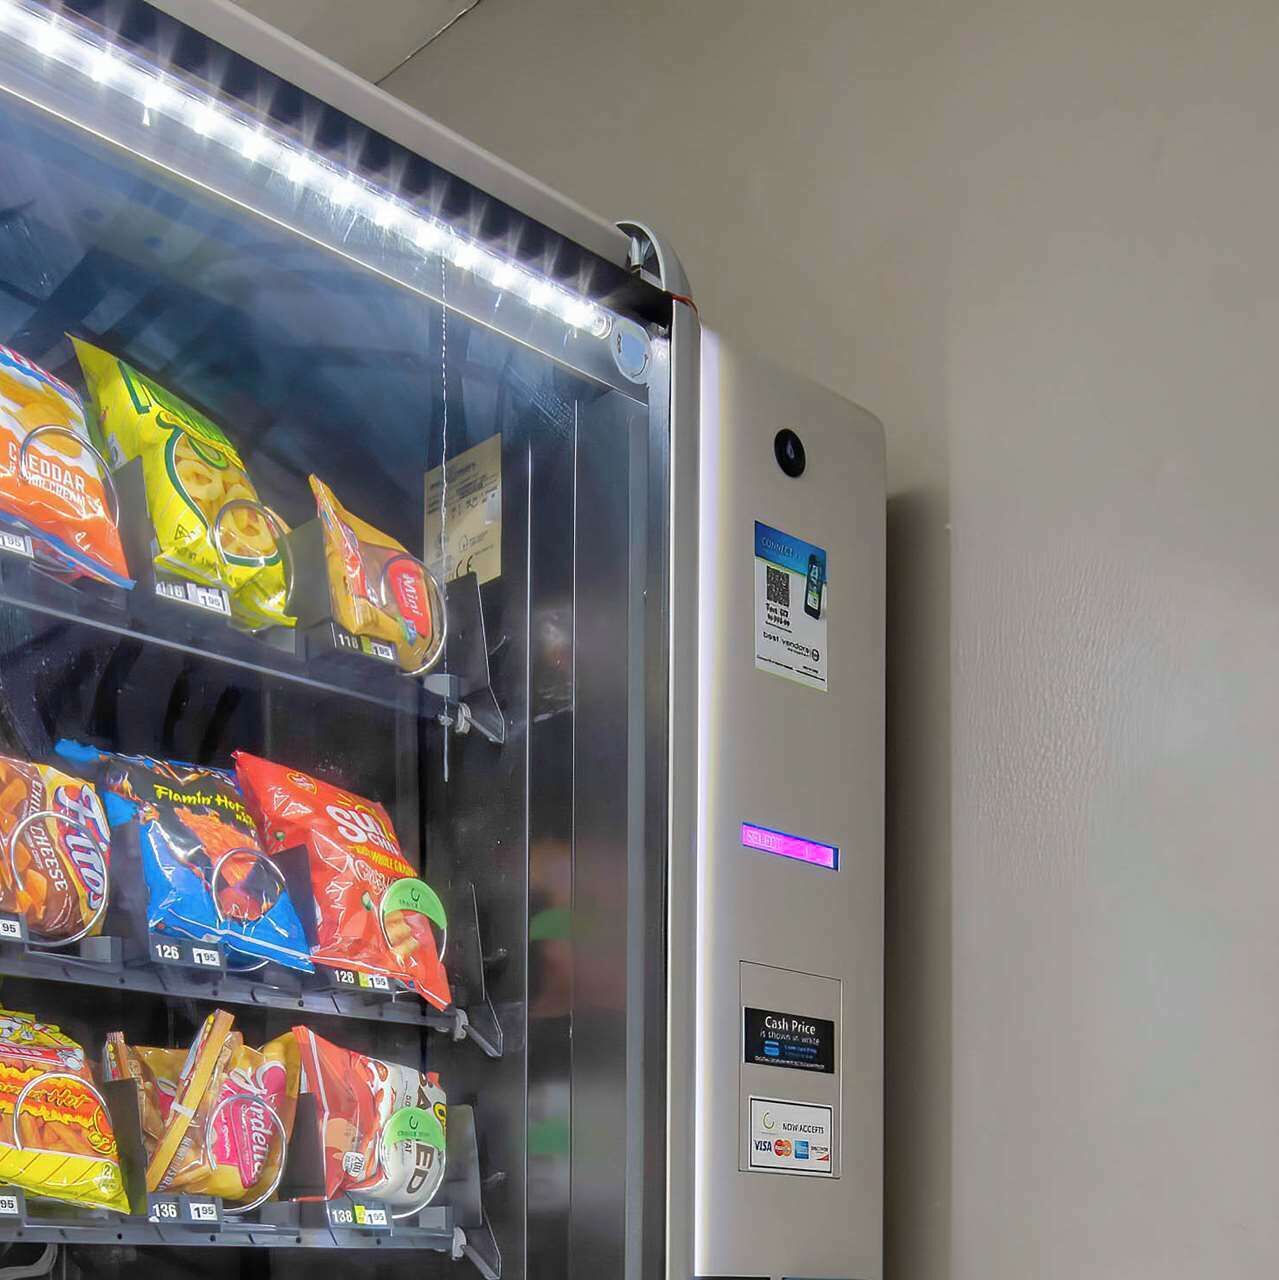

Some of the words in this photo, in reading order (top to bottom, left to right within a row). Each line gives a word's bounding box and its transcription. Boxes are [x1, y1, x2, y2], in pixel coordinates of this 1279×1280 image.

[8, 442, 85, 492] CEDDAR
[55, 784, 111, 911] Fitos
[30, 824, 68, 891] CHEESE
[155, 944, 180, 960] 126
[334, 970, 355, 984] 128
[765, 1016, 789, 1031] Cash
[792, 1020, 816, 1035] Price
[407, 1072, 435, 1194] BAED
[754, 1139, 772, 1152] VISA
[152, 1203, 177, 1218] 136
